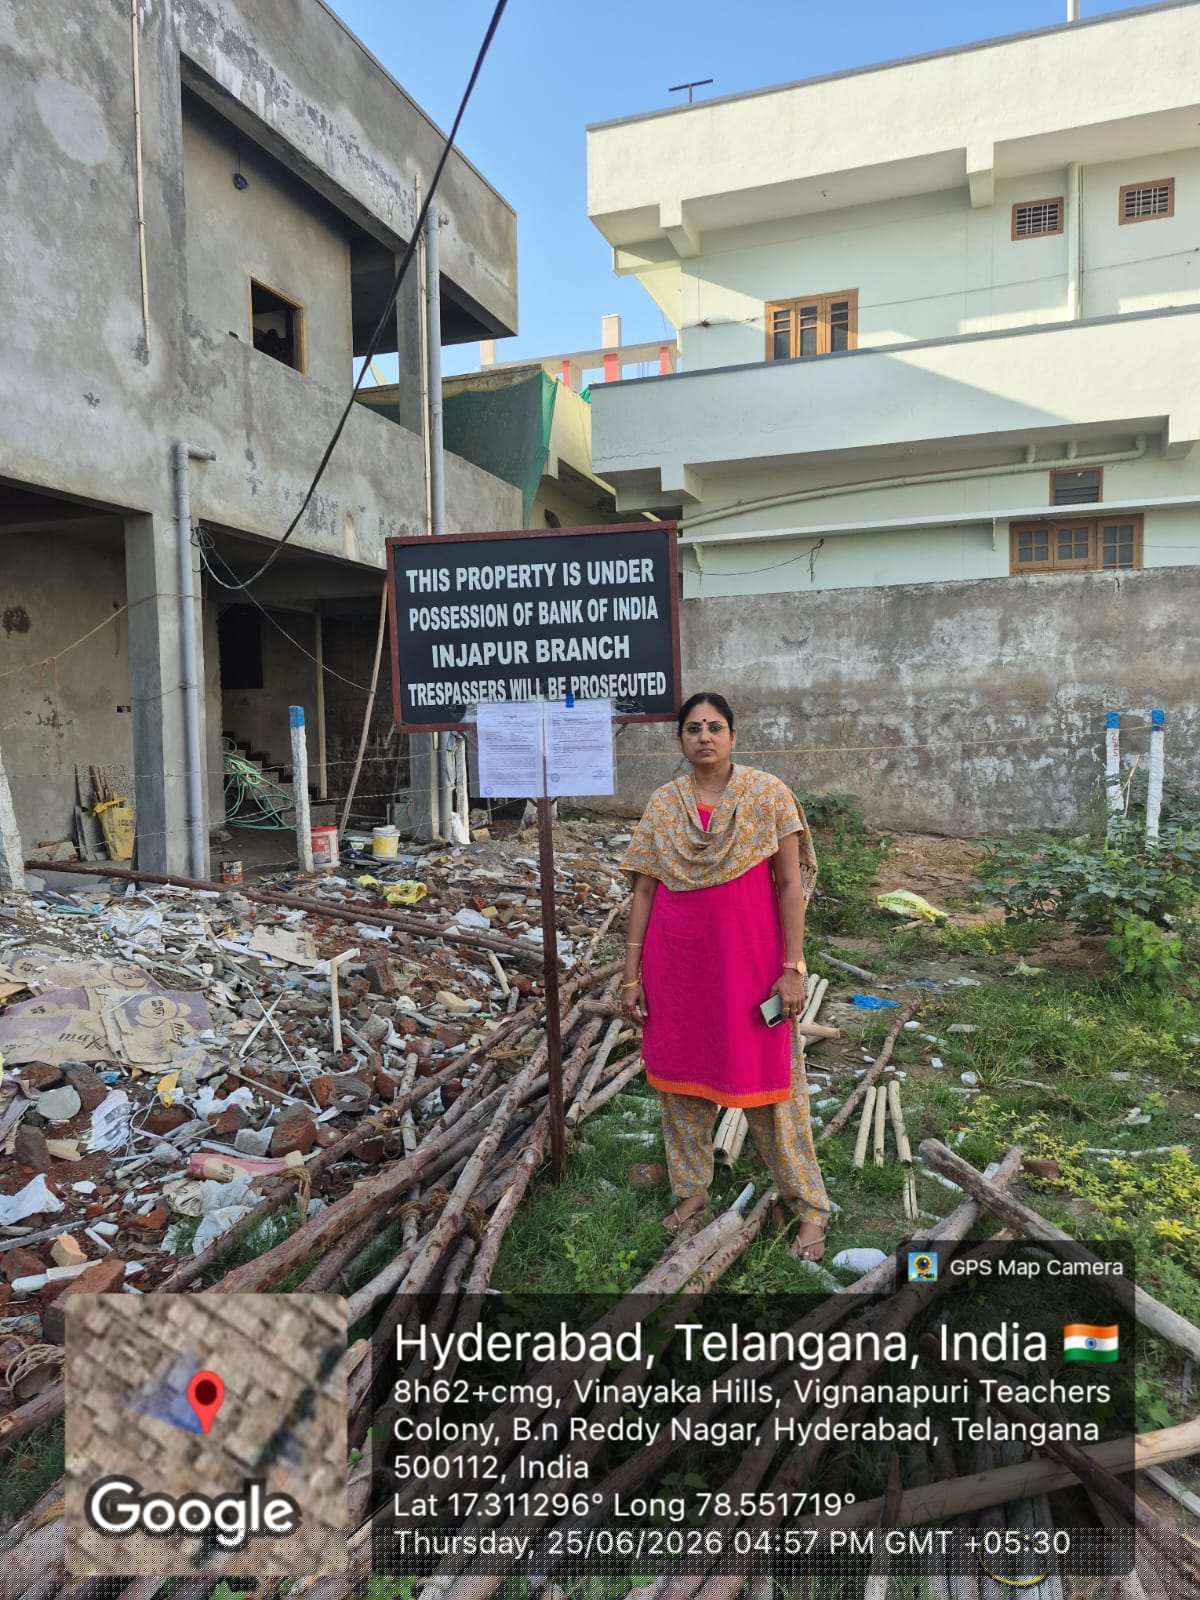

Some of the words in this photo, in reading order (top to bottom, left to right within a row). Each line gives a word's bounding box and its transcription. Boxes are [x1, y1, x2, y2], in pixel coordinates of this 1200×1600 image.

[406, 568, 450, 593] THIS
[456, 562, 556, 591] PROPERTY
[563, 562, 581, 587] IS
[587, 558, 655, 585] UNDER
[409, 603, 508, 631] POSSESSION
[513, 602, 533, 626] OF
[538, 599, 584, 625] BANK
[587, 598, 608, 623] OF
[613, 595, 659, 621] INDIA
[431, 640, 529, 668] INJAPUR
[536, 635, 630, 663] BRANCH
[408, 679, 506, 707] TRESPASSERS
[509, 678, 542, 701] WILL
[548, 677, 566, 699] BE
[571, 672, 666, 699] PROSECUTED
